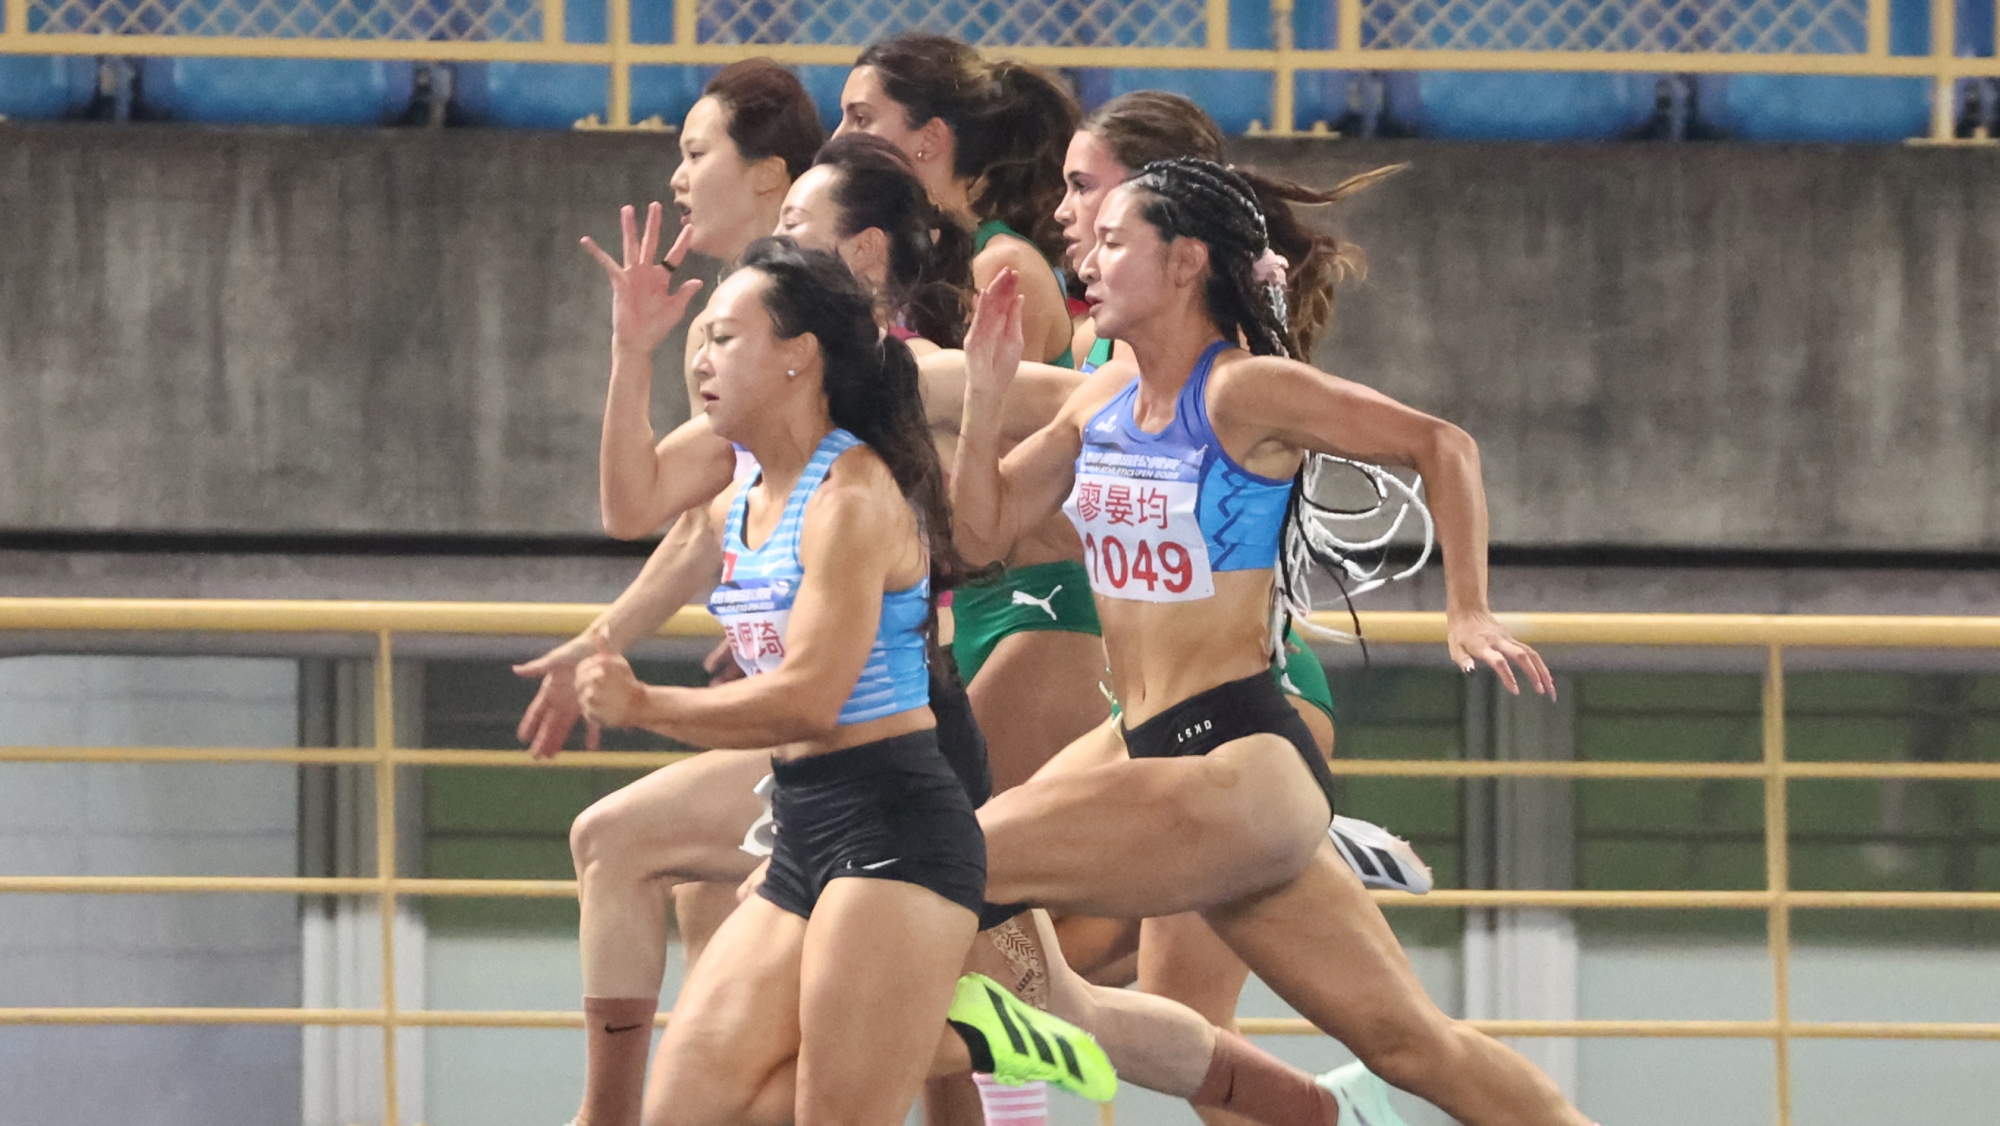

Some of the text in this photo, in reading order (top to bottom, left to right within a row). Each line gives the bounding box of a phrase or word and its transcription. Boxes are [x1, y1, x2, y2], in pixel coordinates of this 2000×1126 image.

[1076, 481, 1169, 530] 廖晏均
[1085, 532, 1193, 594] 1049
